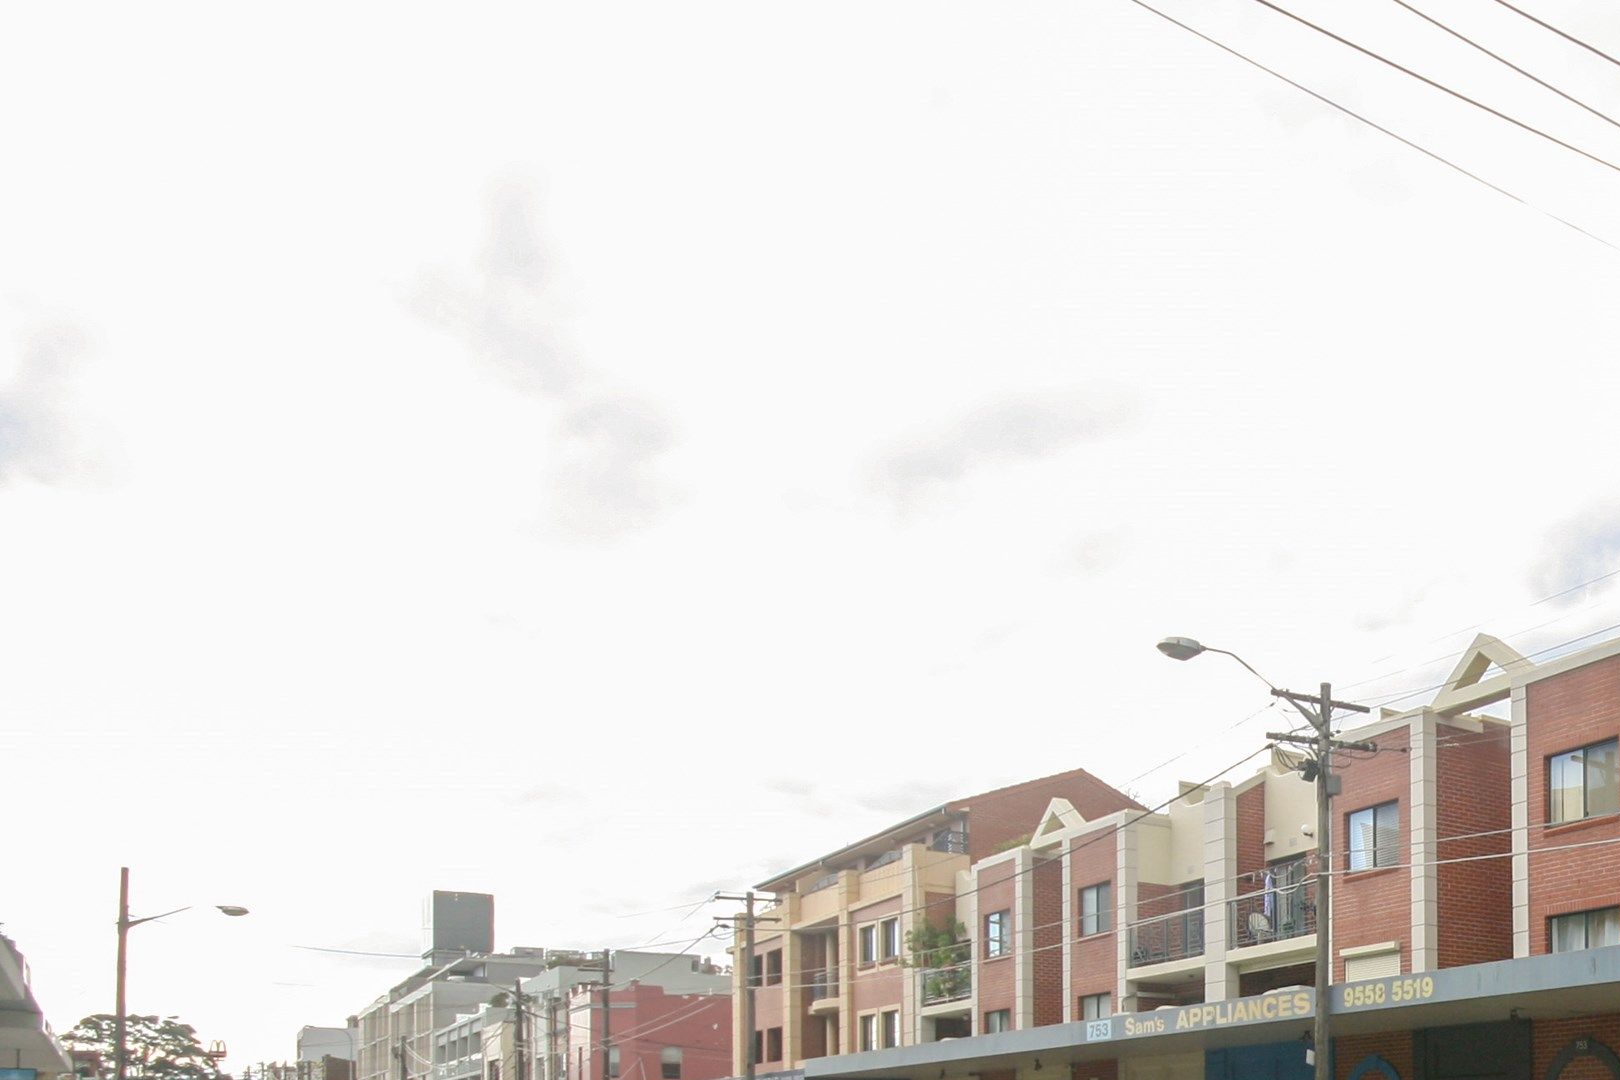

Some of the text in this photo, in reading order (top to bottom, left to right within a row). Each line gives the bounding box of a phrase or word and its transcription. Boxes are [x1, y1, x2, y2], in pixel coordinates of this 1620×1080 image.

[1392, 976, 1434, 1002] 5519
[1124, 992, 1312, 1036] Sam's APPLIANCES
[1088, 1022, 1109, 1039] 753
